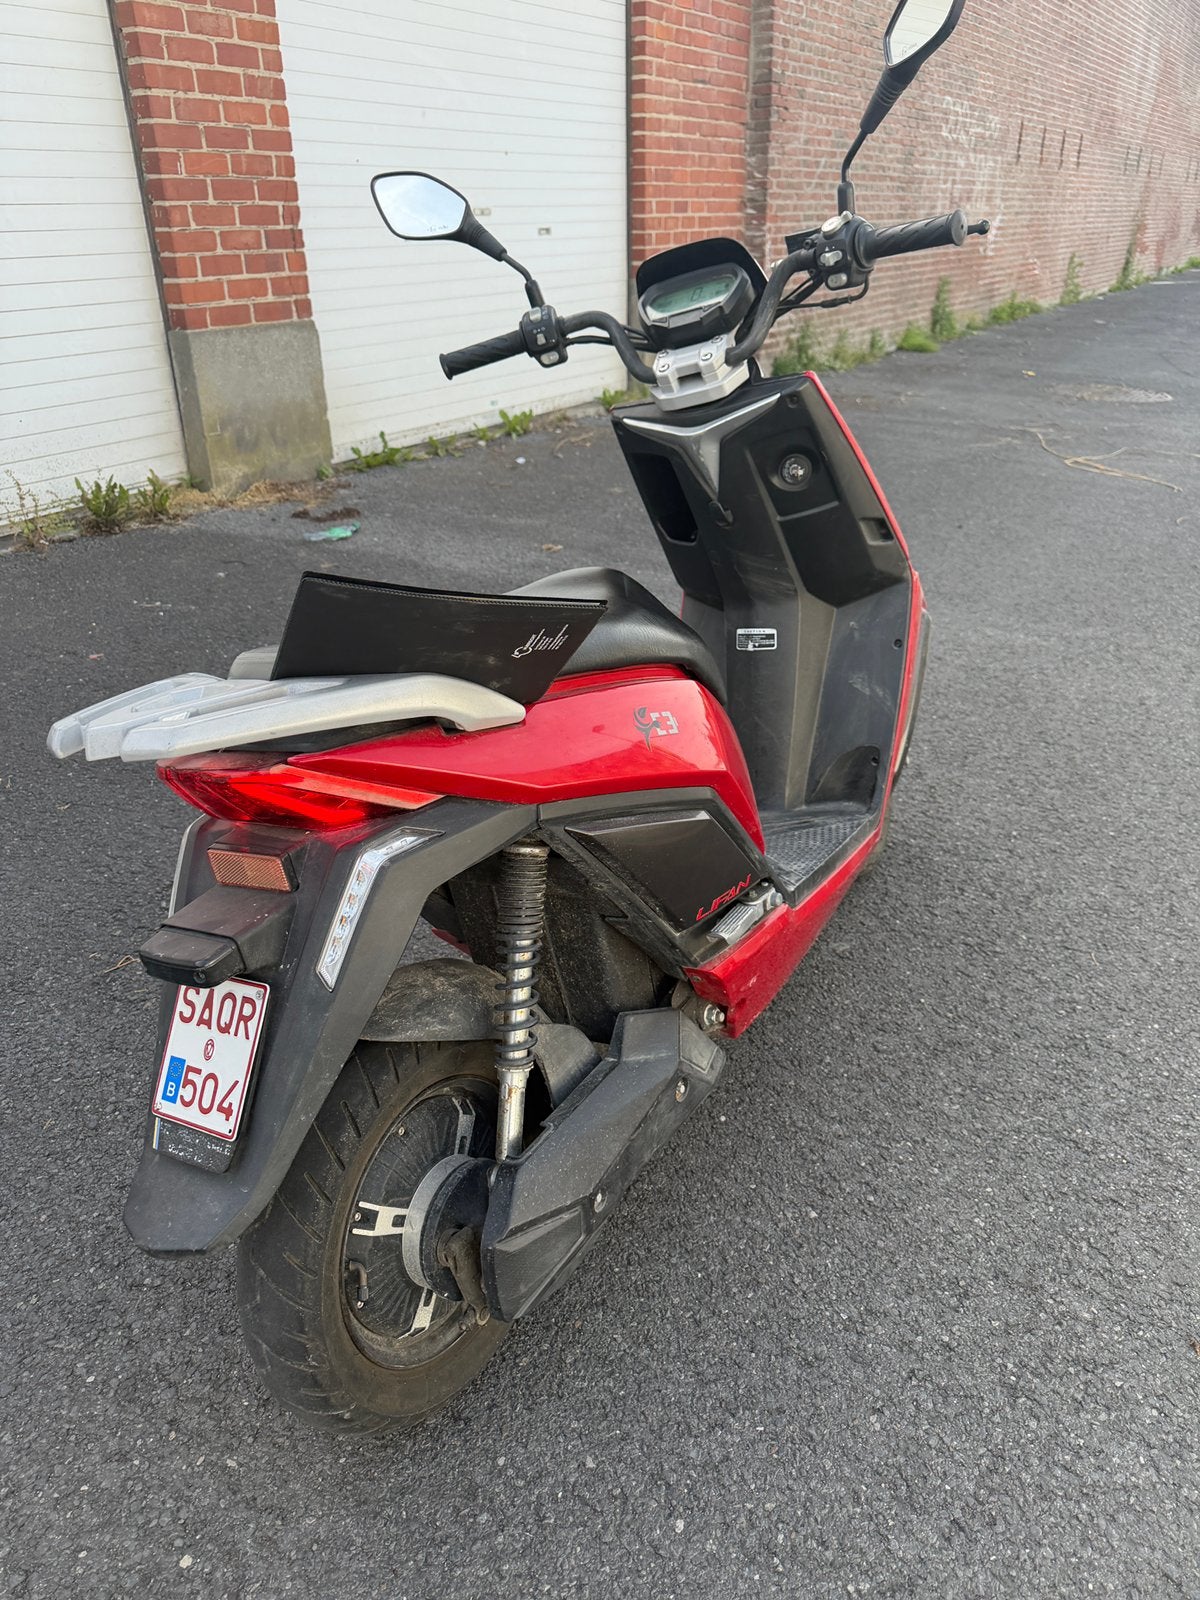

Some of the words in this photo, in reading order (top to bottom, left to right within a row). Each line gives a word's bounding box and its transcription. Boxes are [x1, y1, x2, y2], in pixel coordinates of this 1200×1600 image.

[696, 873, 752, 921] LIFAN
[178, 987, 257, 1041] SAQR
[166, 1081, 176, 1098] B
[179, 1064, 240, 1122] 504
